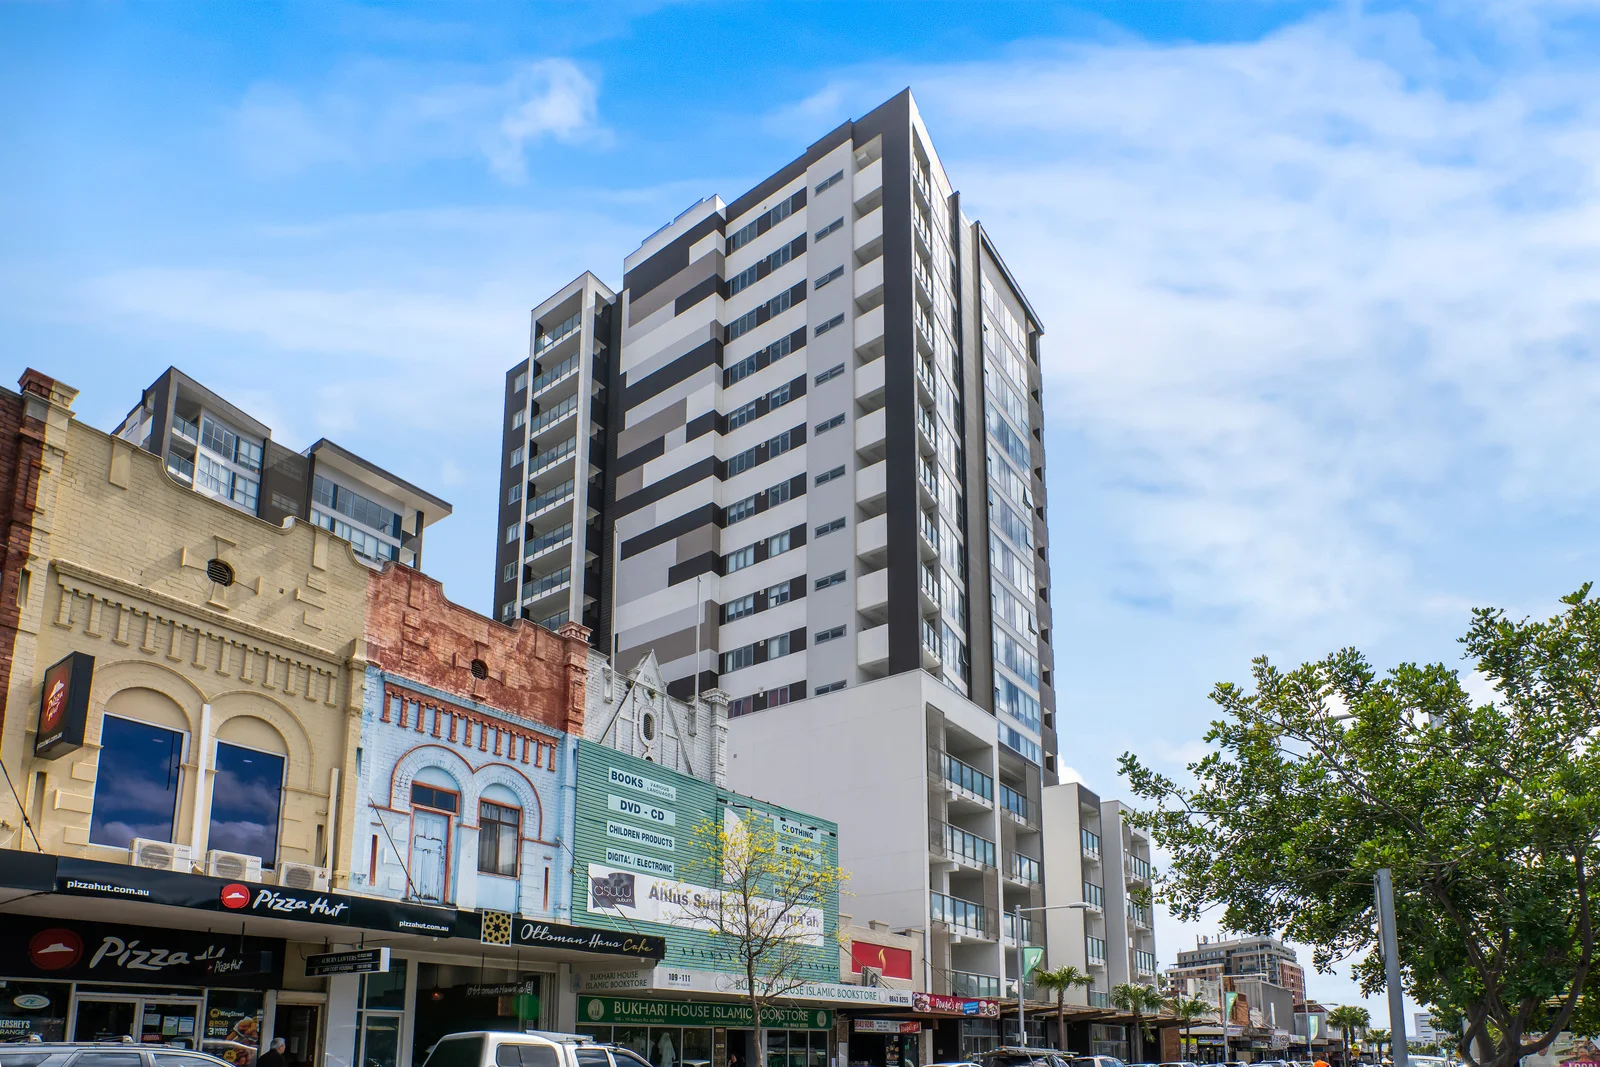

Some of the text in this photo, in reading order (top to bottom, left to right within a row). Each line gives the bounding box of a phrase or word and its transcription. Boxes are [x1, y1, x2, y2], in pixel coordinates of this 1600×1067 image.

[611, 770, 644, 788] BOOKS
[650, 782, 669, 792] VARIOUS
[647, 787, 673, 799] LANGUAGES
[620, 799, 641, 814] DVD
[651, 809, 664, 821] CD
[609, 825, 673, 848] CHILDREN PRODUCTS
[608, 851, 631, 865] DIGITAL
[636, 858, 673, 873] ELECTRONIC
[67, 879, 149, 897] pizzahut.com.au
[252, 889, 348, 918] Pizza Hut
[399, 920, 449, 932] pizzahut.com.au
[520, 923, 653, 953] Ottoman Haus Cafe
[89, 936, 190, 971] Pizza
[214, 959, 243, 974] Pizza Hut
[590, 970, 638, 981] BUKHARI HOUSE
[585, 979, 647, 990] ISLAMIC BOOKSTORE
[806, 986, 834, 997] ISLAMIC
[837, 988, 877, 1000] BOOKSTORE
[613, 1001, 808, 1021] BUKHARI HOUSE ISLAMIC OOKSTORE
[207, 1027, 215, 1036] 3
